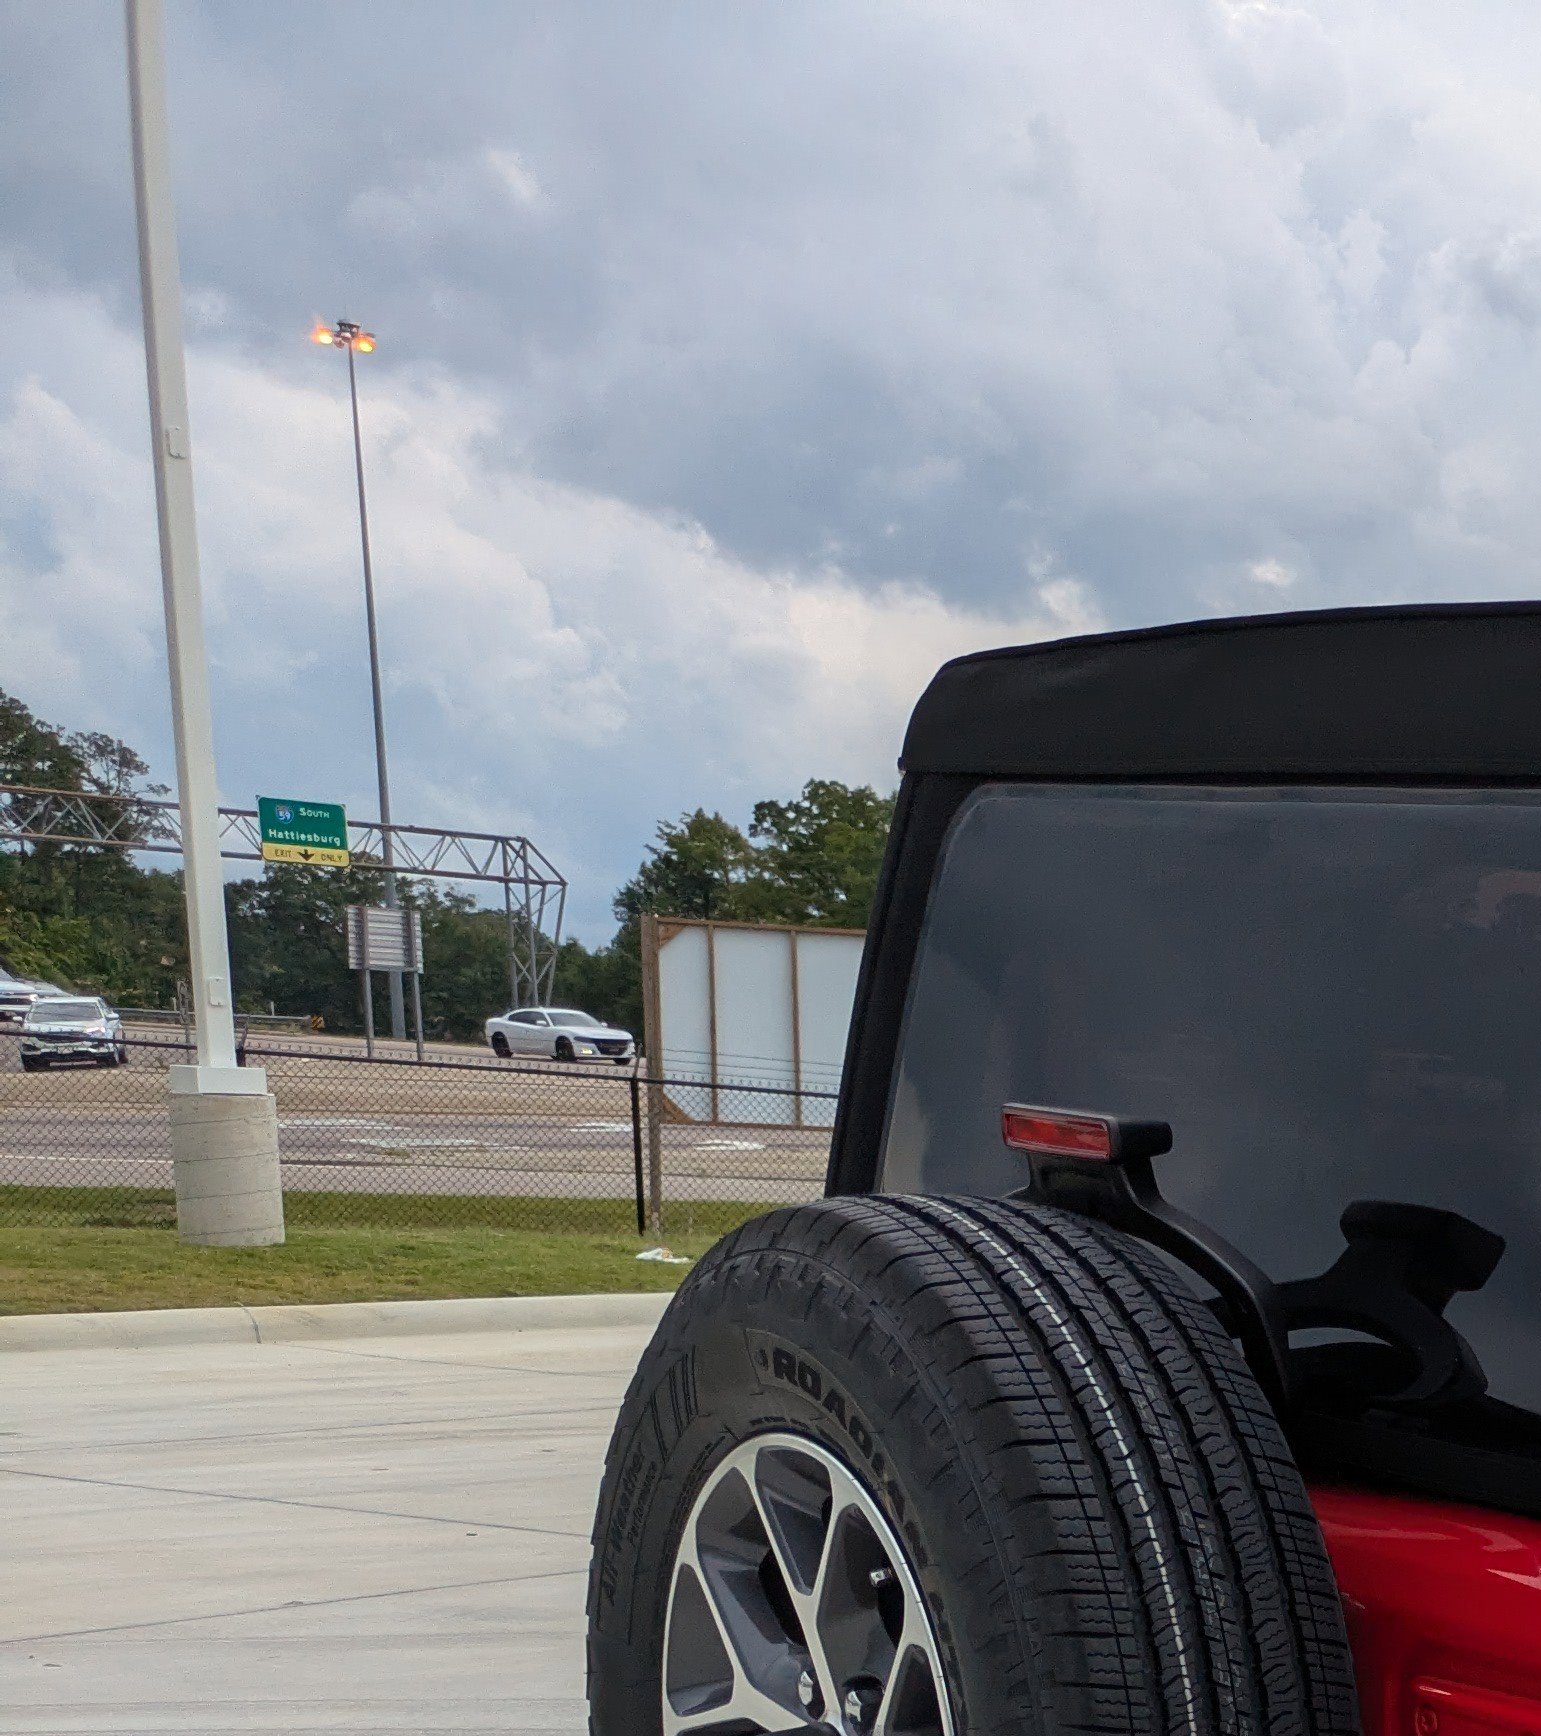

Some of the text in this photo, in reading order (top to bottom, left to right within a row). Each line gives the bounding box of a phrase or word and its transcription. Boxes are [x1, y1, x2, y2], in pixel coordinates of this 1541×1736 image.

[268, 828, 341, 846] Hattiesburg
[274, 849, 343, 862] EXIT ONLY
